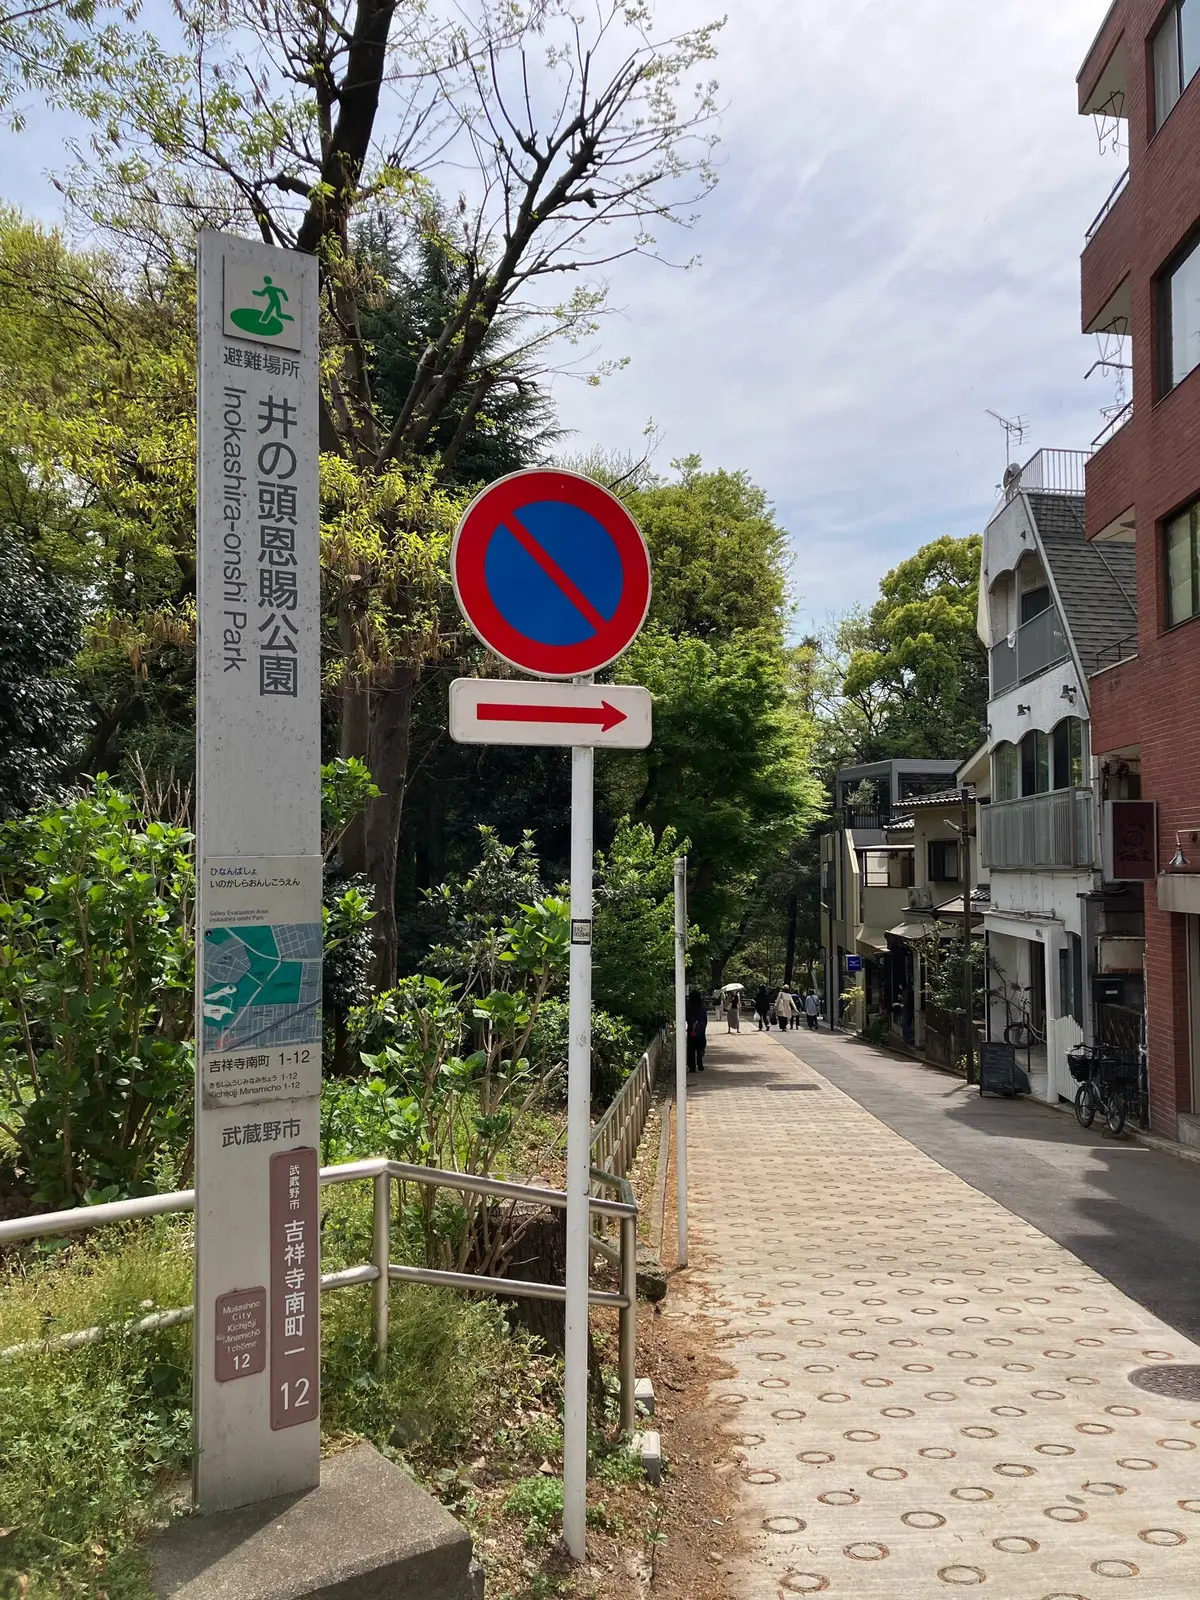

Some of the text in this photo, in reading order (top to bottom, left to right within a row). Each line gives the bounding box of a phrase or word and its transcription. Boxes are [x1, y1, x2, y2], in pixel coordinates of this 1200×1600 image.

[223, 345, 300, 379] 避難場所
[222, 385, 248, 673] Inokashira-onshi Park
[257, 394, 300, 698] 井の頭恩賜公園
[209, 867, 258, 876] ひなんばしょ
[209, 877, 301, 889] いのかしらおんしこうえん
[209, 1049, 310, 1073] 吉祥寺南町 1-12
[209, 1072, 298, 1089] きちじょうじみなみちょう 1-12
[239, 1083, 282, 1096] Minamicho
[284, 1081, 300, 1090] 1-12
[222, 1118, 301, 1147] 武蔵野市
[289, 1164, 301, 1211] 武蔵野市
[222, 1300, 261, 1316] Musashino
[232, 1311, 252, 1322] City
[233, 1352, 251, 1371] 12
[280, 1377, 310, 1411] 12
